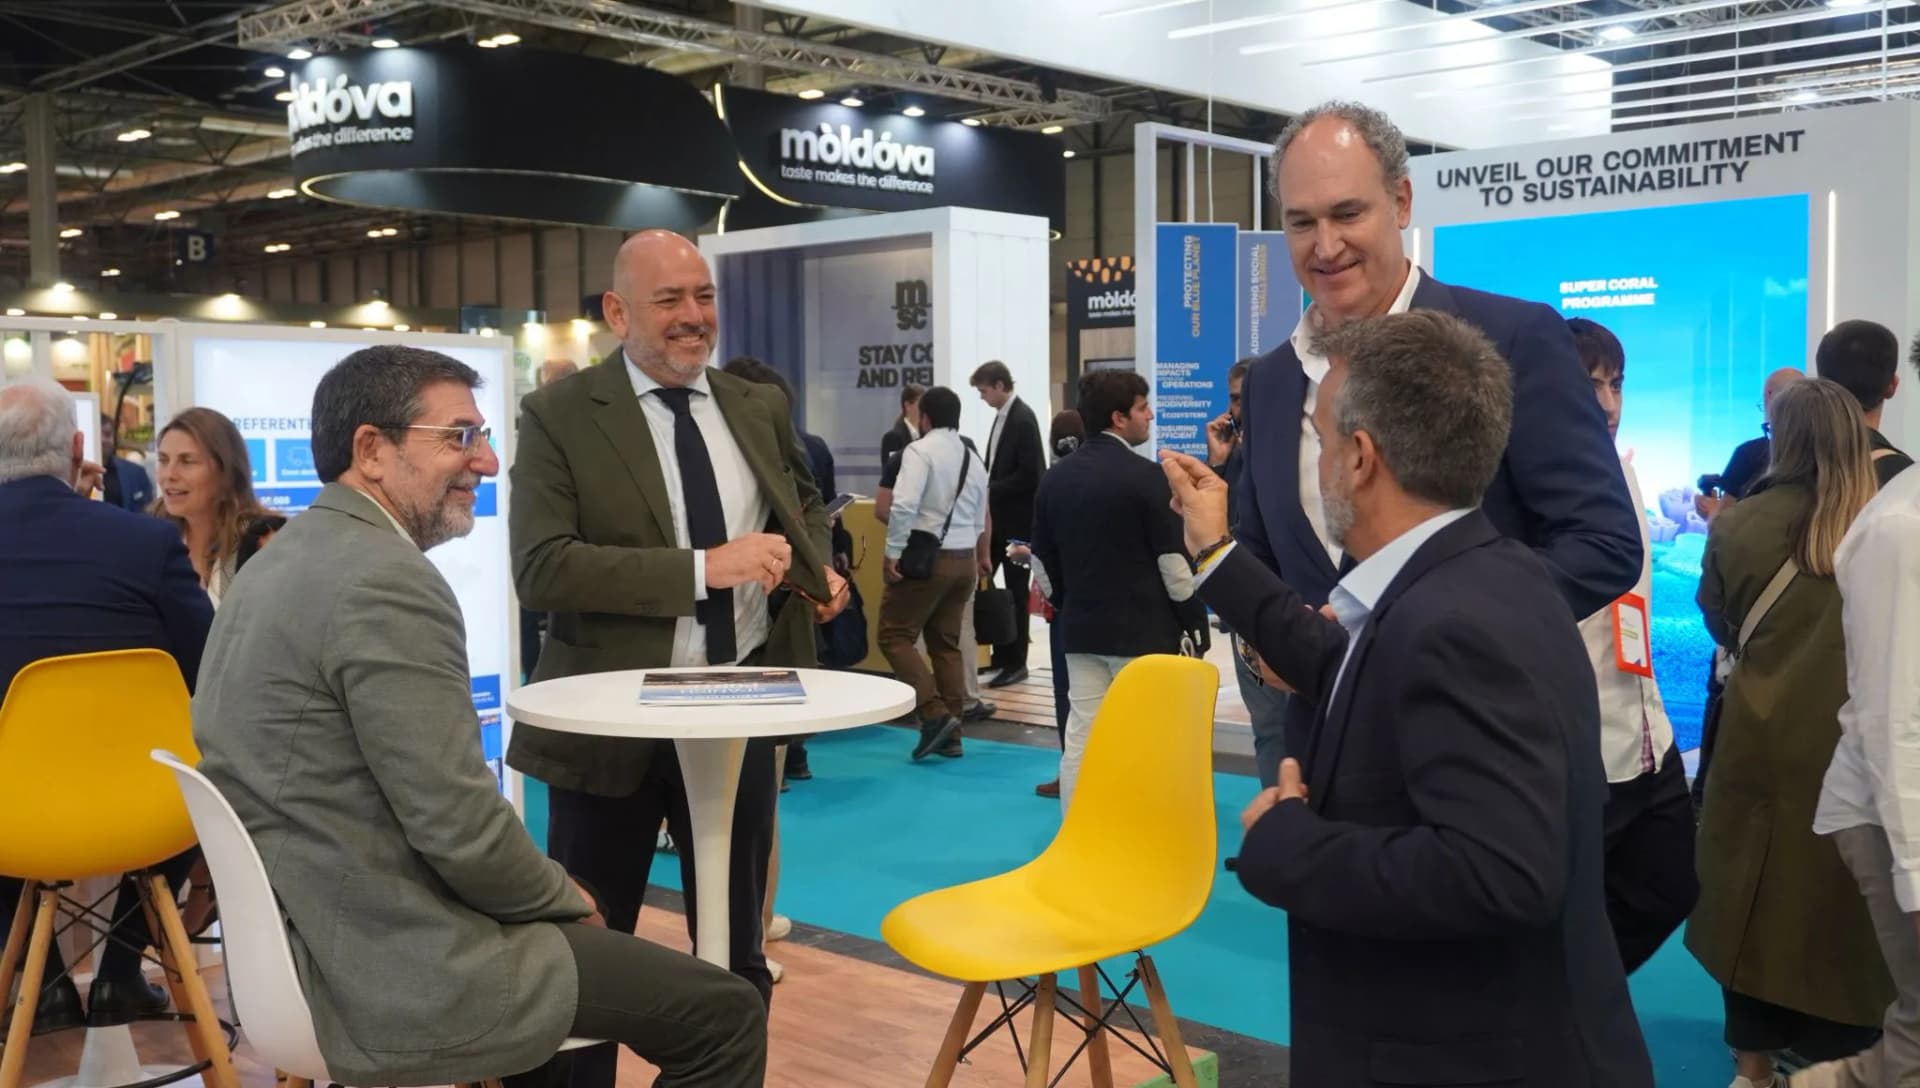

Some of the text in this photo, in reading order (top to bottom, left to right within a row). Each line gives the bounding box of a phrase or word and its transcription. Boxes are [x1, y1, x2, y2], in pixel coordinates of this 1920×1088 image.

[334, 126, 413, 145] difference
[781, 122, 935, 176] mòldóva
[1437, 129, 1805, 188] UNVEIL OUR COMMITMENT
[781, 165, 935, 195] taste makes the difference
[1479, 161, 1750, 207] TO SUSTAINABILITY
[188, 235, 206, 260] B
[1184, 235, 1192, 308] PROTECTING
[1251, 243, 1260, 284] SOCIAL
[1559, 276, 1658, 294] SUPER CORAL
[1562, 293, 1655, 309] PROGRAMME
[1192, 313, 1200, 337] OUR
[858, 344, 908, 366] STAY
[856, 367, 899, 388] AND
[1162, 381, 1214, 389] OPERATIONS
